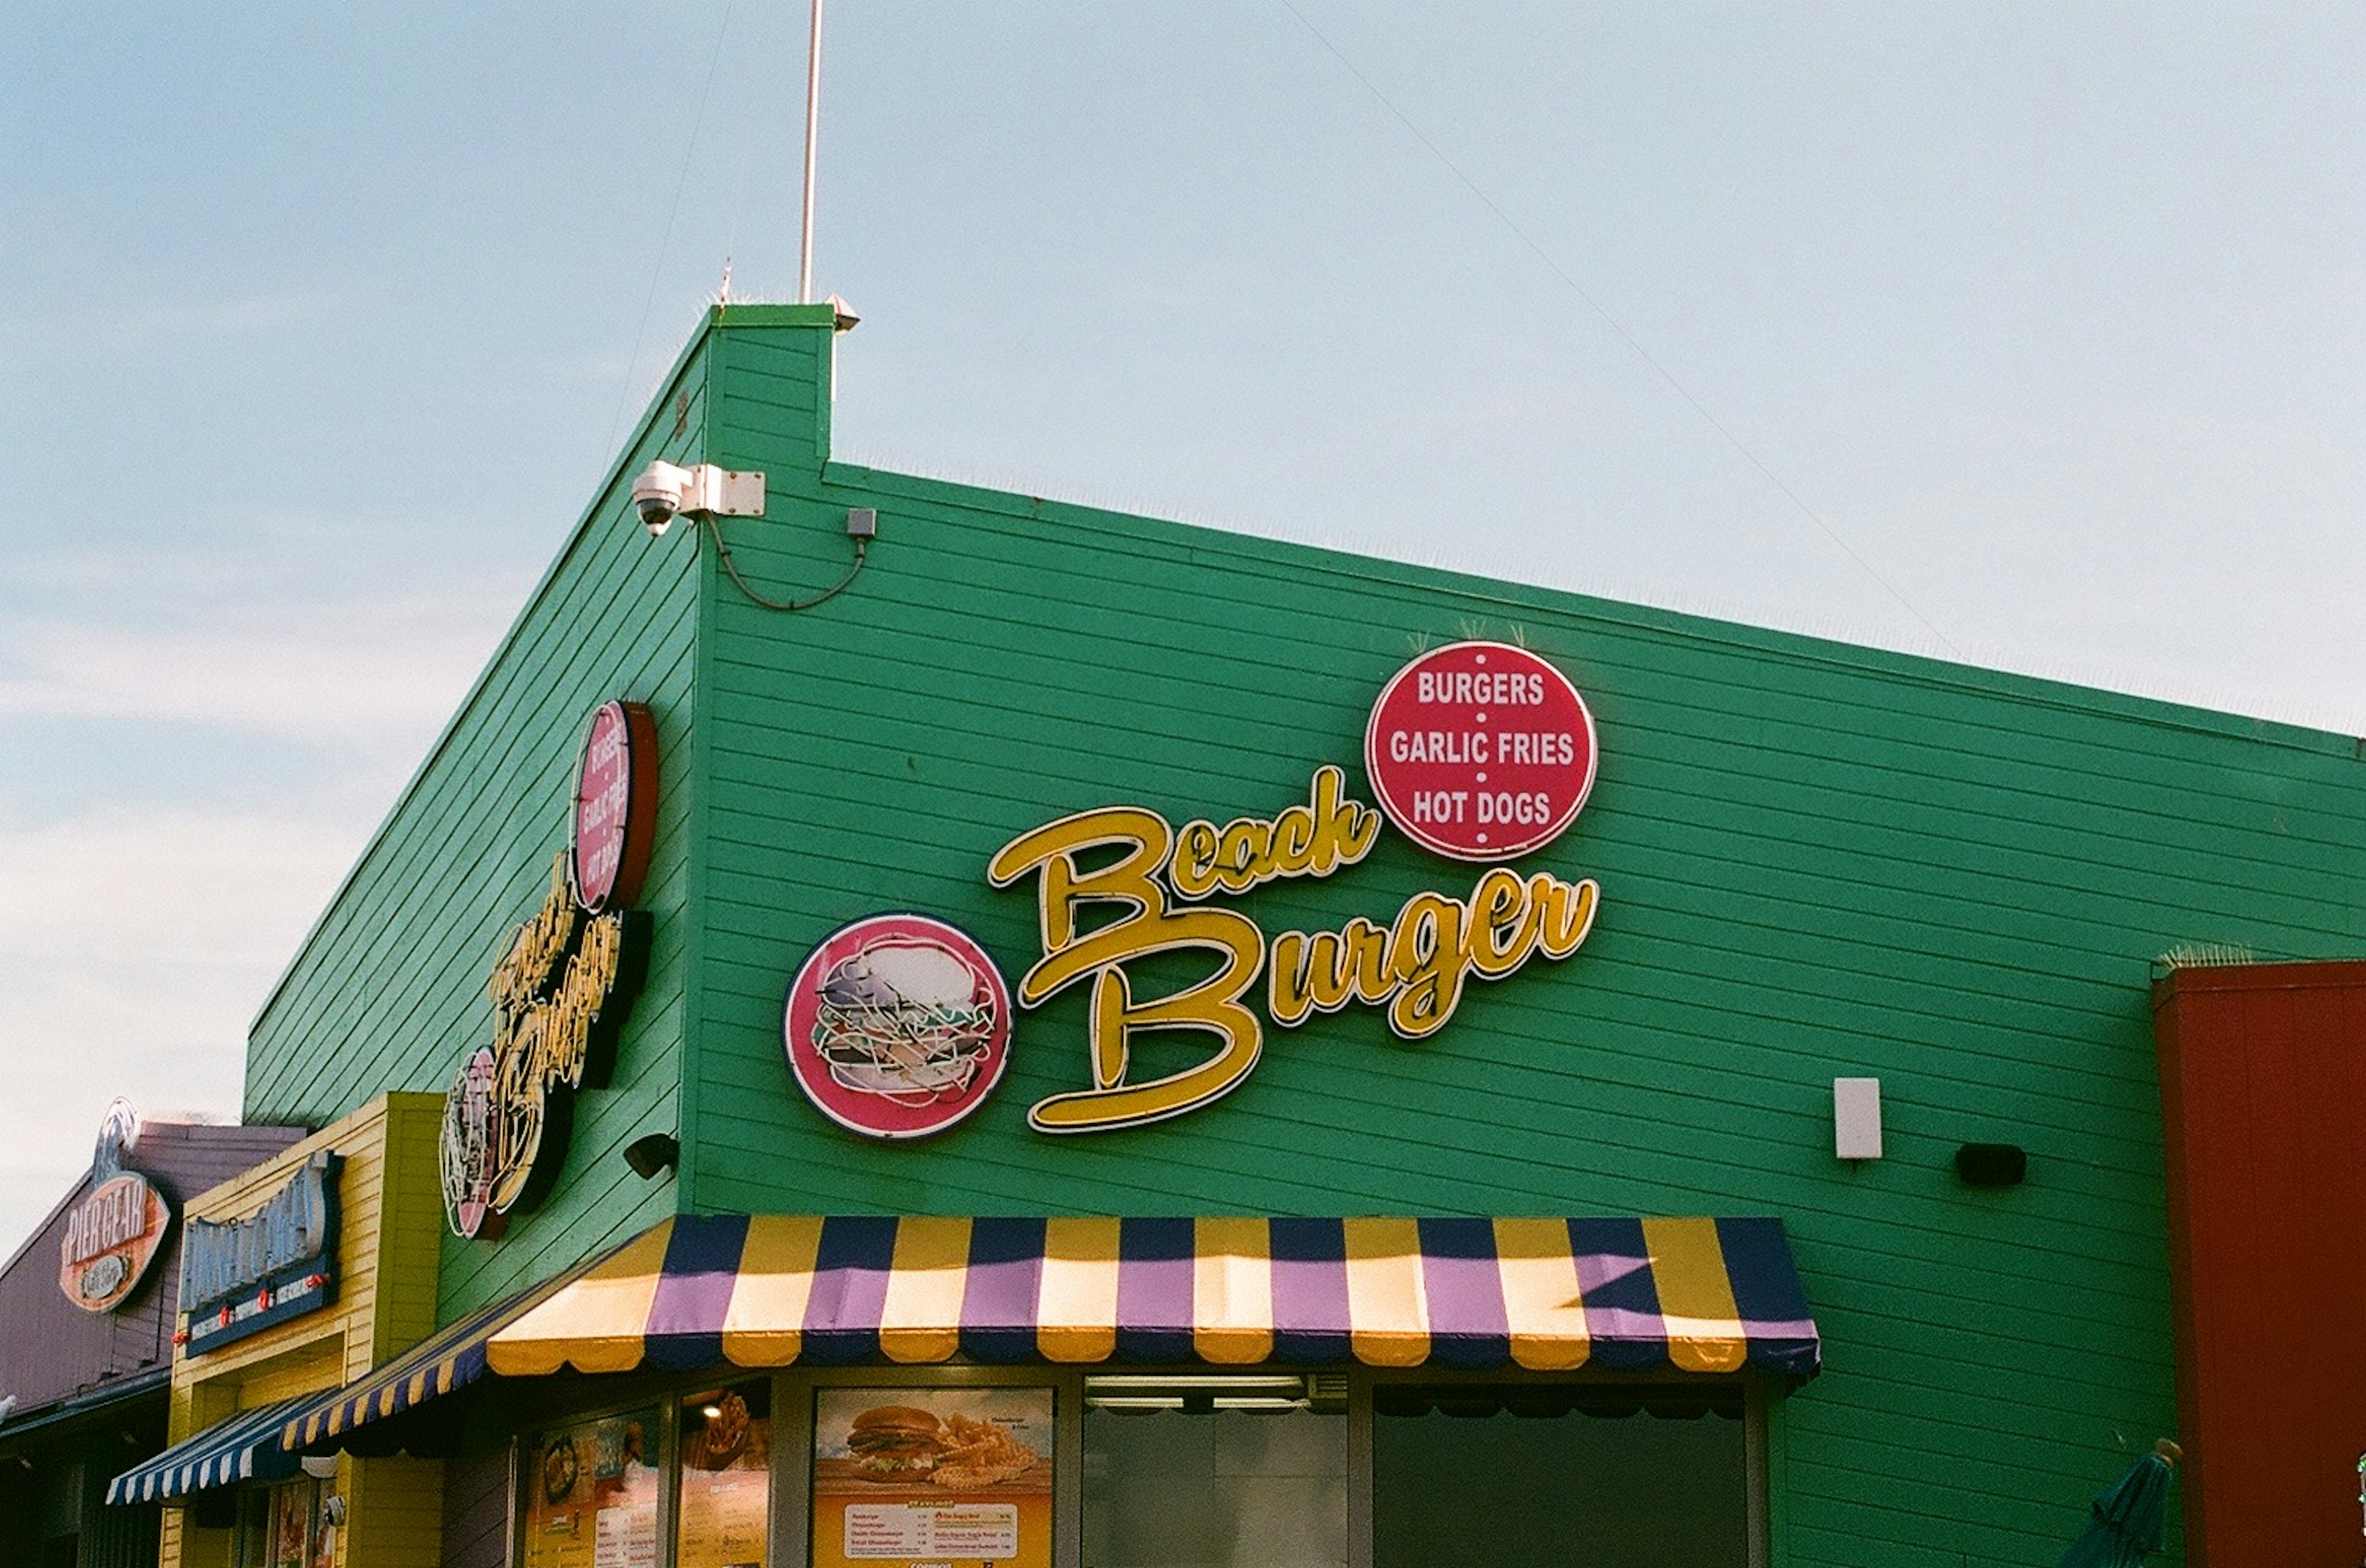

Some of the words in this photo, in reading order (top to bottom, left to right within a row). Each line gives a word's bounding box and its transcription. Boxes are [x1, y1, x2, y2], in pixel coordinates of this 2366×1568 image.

[1418, 672, 1545, 705] BURGERS
[1389, 731, 1489, 763] GARLIC
[1498, 733, 1574, 765] FRIES
[1413, 791, 1468, 823] HOT
[1478, 792, 1551, 825] DOGS
[988, 765, 1381, 955] Beach
[1018, 866, 1600, 1134] Burger
[66, 1198, 102, 1267] PIER
[102, 1177, 146, 1251] GEAR
